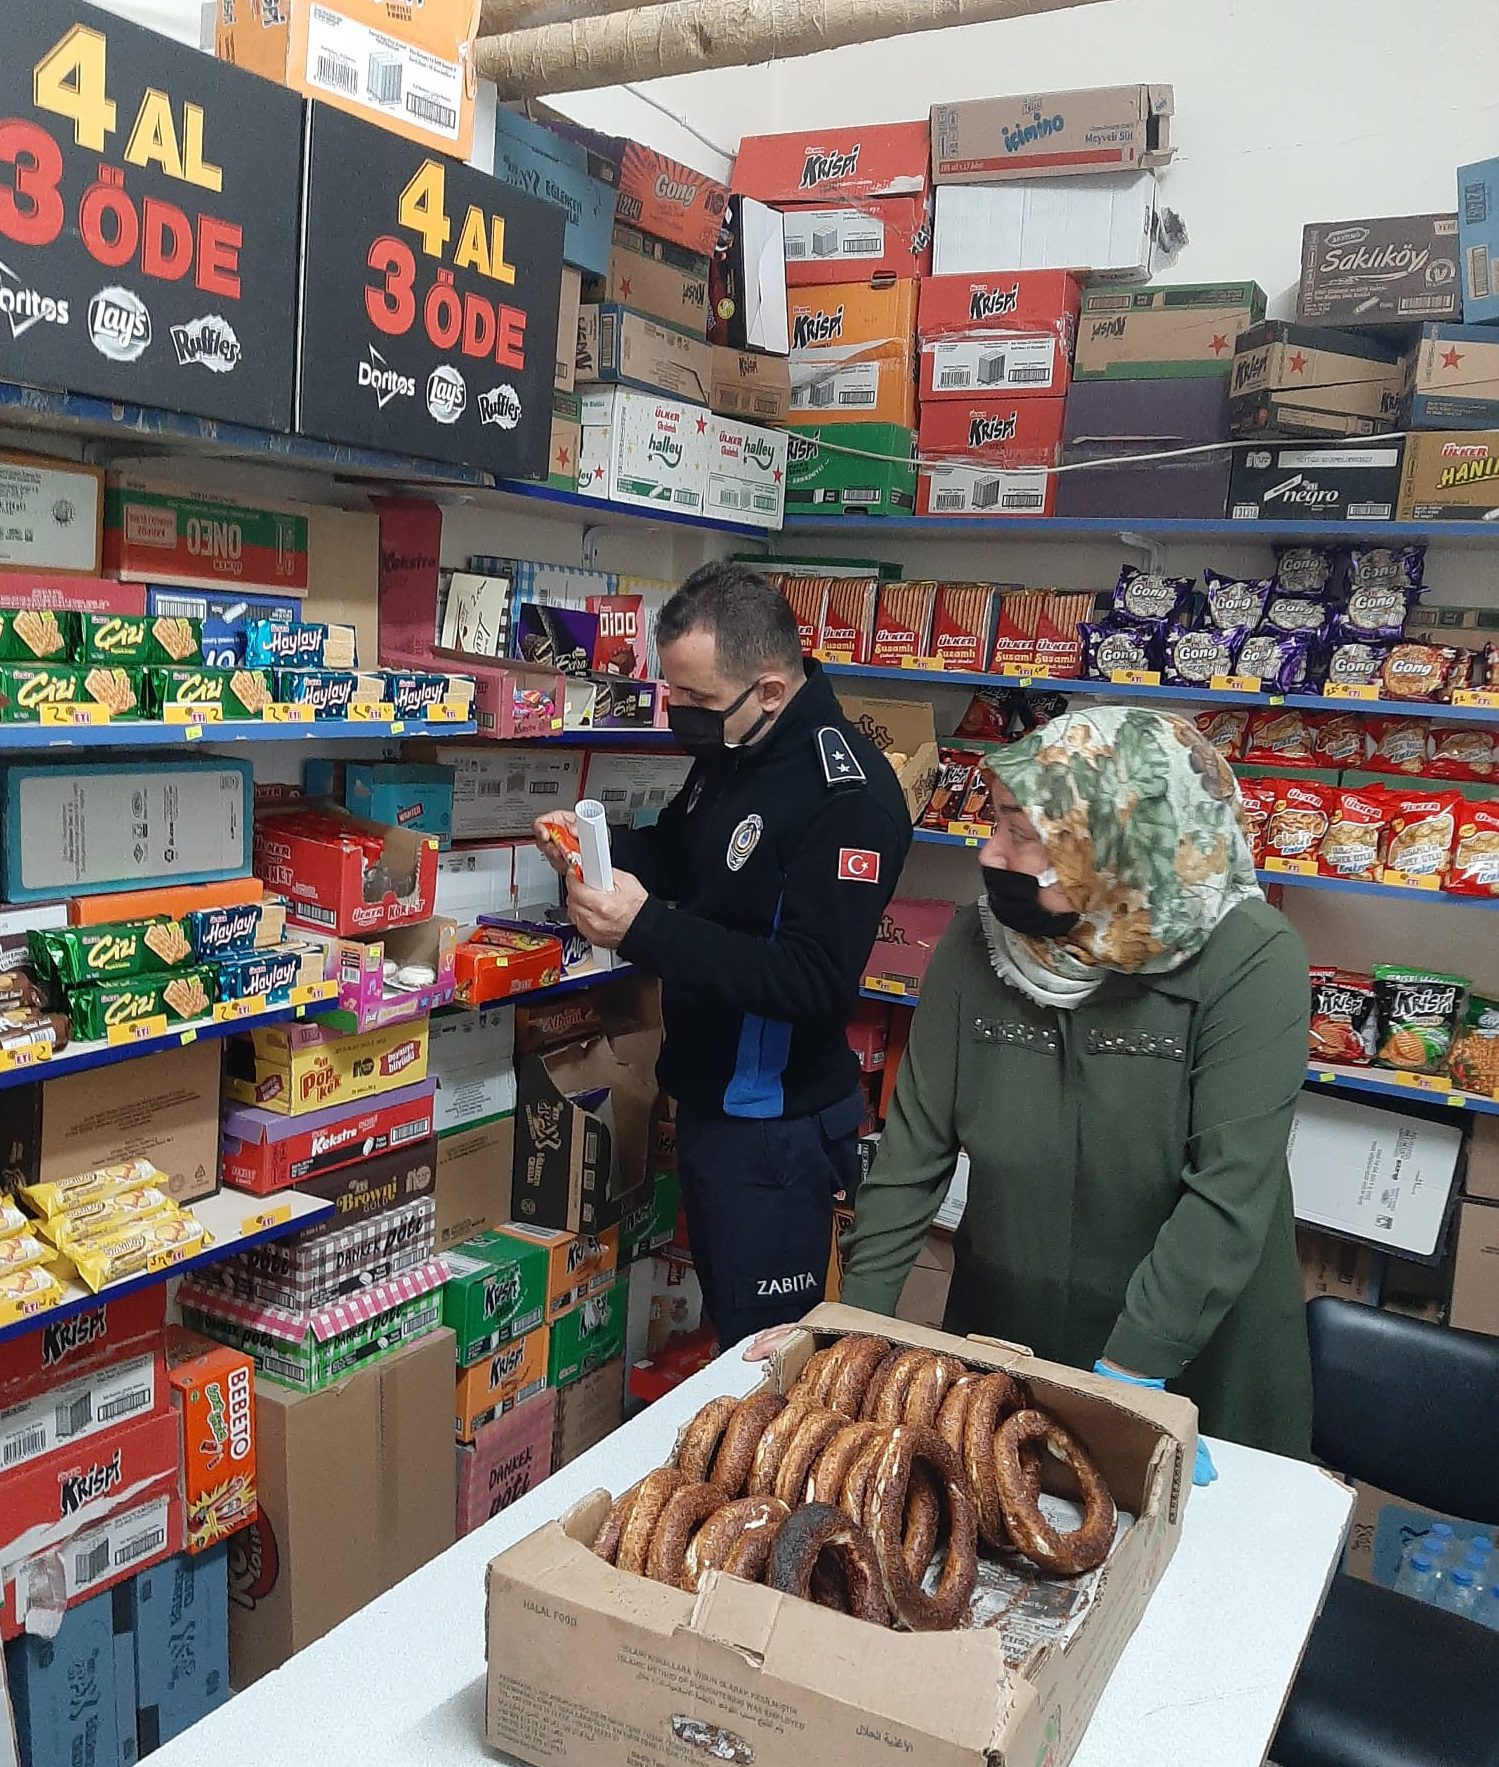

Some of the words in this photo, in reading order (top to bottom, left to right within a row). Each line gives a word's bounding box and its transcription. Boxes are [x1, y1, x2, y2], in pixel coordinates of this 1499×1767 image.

[34, 23, 116, 152] 4
[125, 87, 222, 192] AL
[655, 173, 698, 207] Gong
[0, 118, 64, 246] 3
[79, 162, 243, 300] ÖDE
[398, 158, 450, 258] 4
[454, 205, 516, 285] AL
[0, 286, 69, 325] oritos
[365, 235, 416, 335] 3
[424, 267, 527, 370] ÖDE
[94, 297, 146, 347] Lay's
[171, 325, 240, 367] Ruffles
[358, 360, 416, 397] Doritos
[430, 376, 464, 411] Lay's
[649, 433, 682, 466] halley
[744, 436, 774, 466] halley
[1282, 487, 1340, 507] negro
[1132, 584, 1168, 599] Gong
[1355, 593, 1397, 609] Gong
[876, 630, 914, 642] ÜLKER
[938, 634, 976, 647] ÜLKER
[1037, 640, 1078, 652] ÜLKER
[1103, 649, 1138, 662] Gong
[1180, 646, 1217, 660] Gong
[1335, 659, 1376, 674] Gong
[1391, 659, 1432, 676] Gong
[757, 1272, 817, 1295] ZABITA
[229, 1367, 250, 1459] BEBETO
[553, 1610, 577, 1627] FOOD
